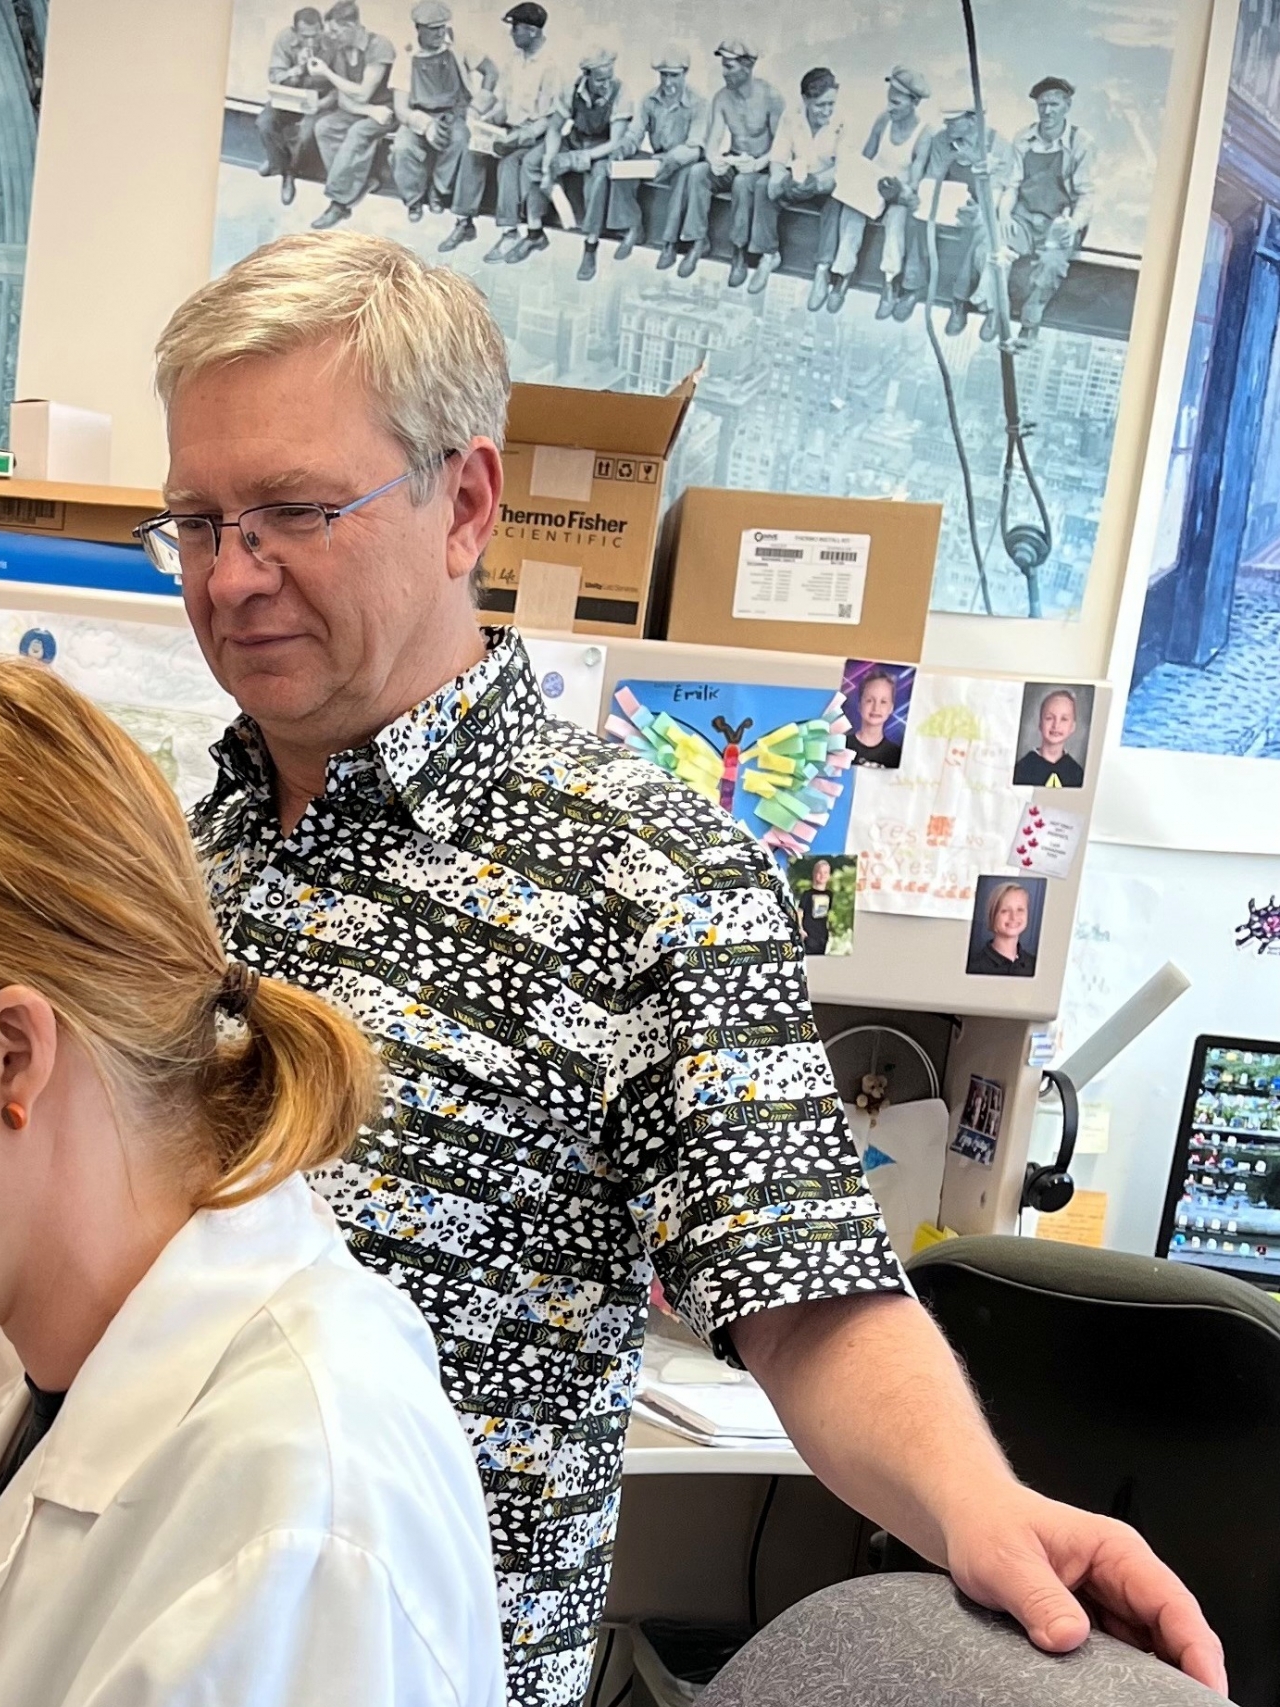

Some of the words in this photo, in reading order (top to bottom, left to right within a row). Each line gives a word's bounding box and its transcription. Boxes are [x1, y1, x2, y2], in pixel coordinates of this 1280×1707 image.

[499, 503, 566, 528] Thermo
[567, 510, 628, 533] Fisher
[491, 525, 623, 549] SCIENTIFIC
